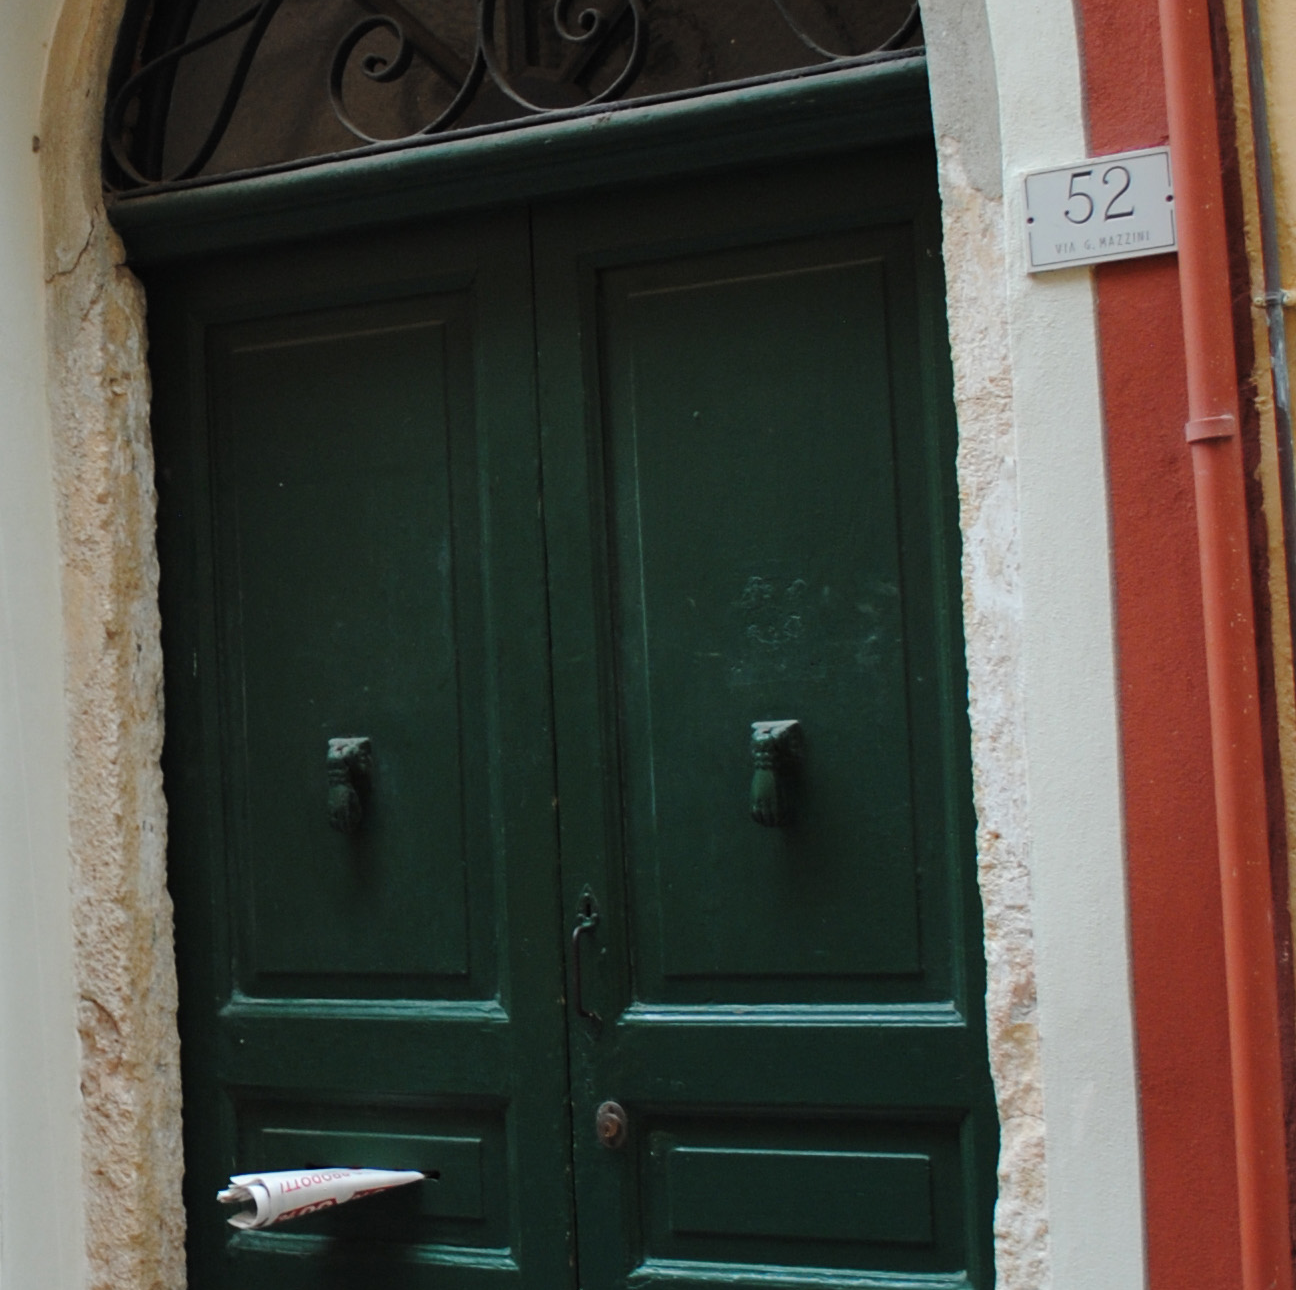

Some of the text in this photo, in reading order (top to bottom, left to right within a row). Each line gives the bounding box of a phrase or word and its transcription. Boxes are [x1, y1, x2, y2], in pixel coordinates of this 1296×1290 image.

[1064, 165, 1135, 225] 52
[1055, 230, 1150, 255] VIA G. MAZZINI
